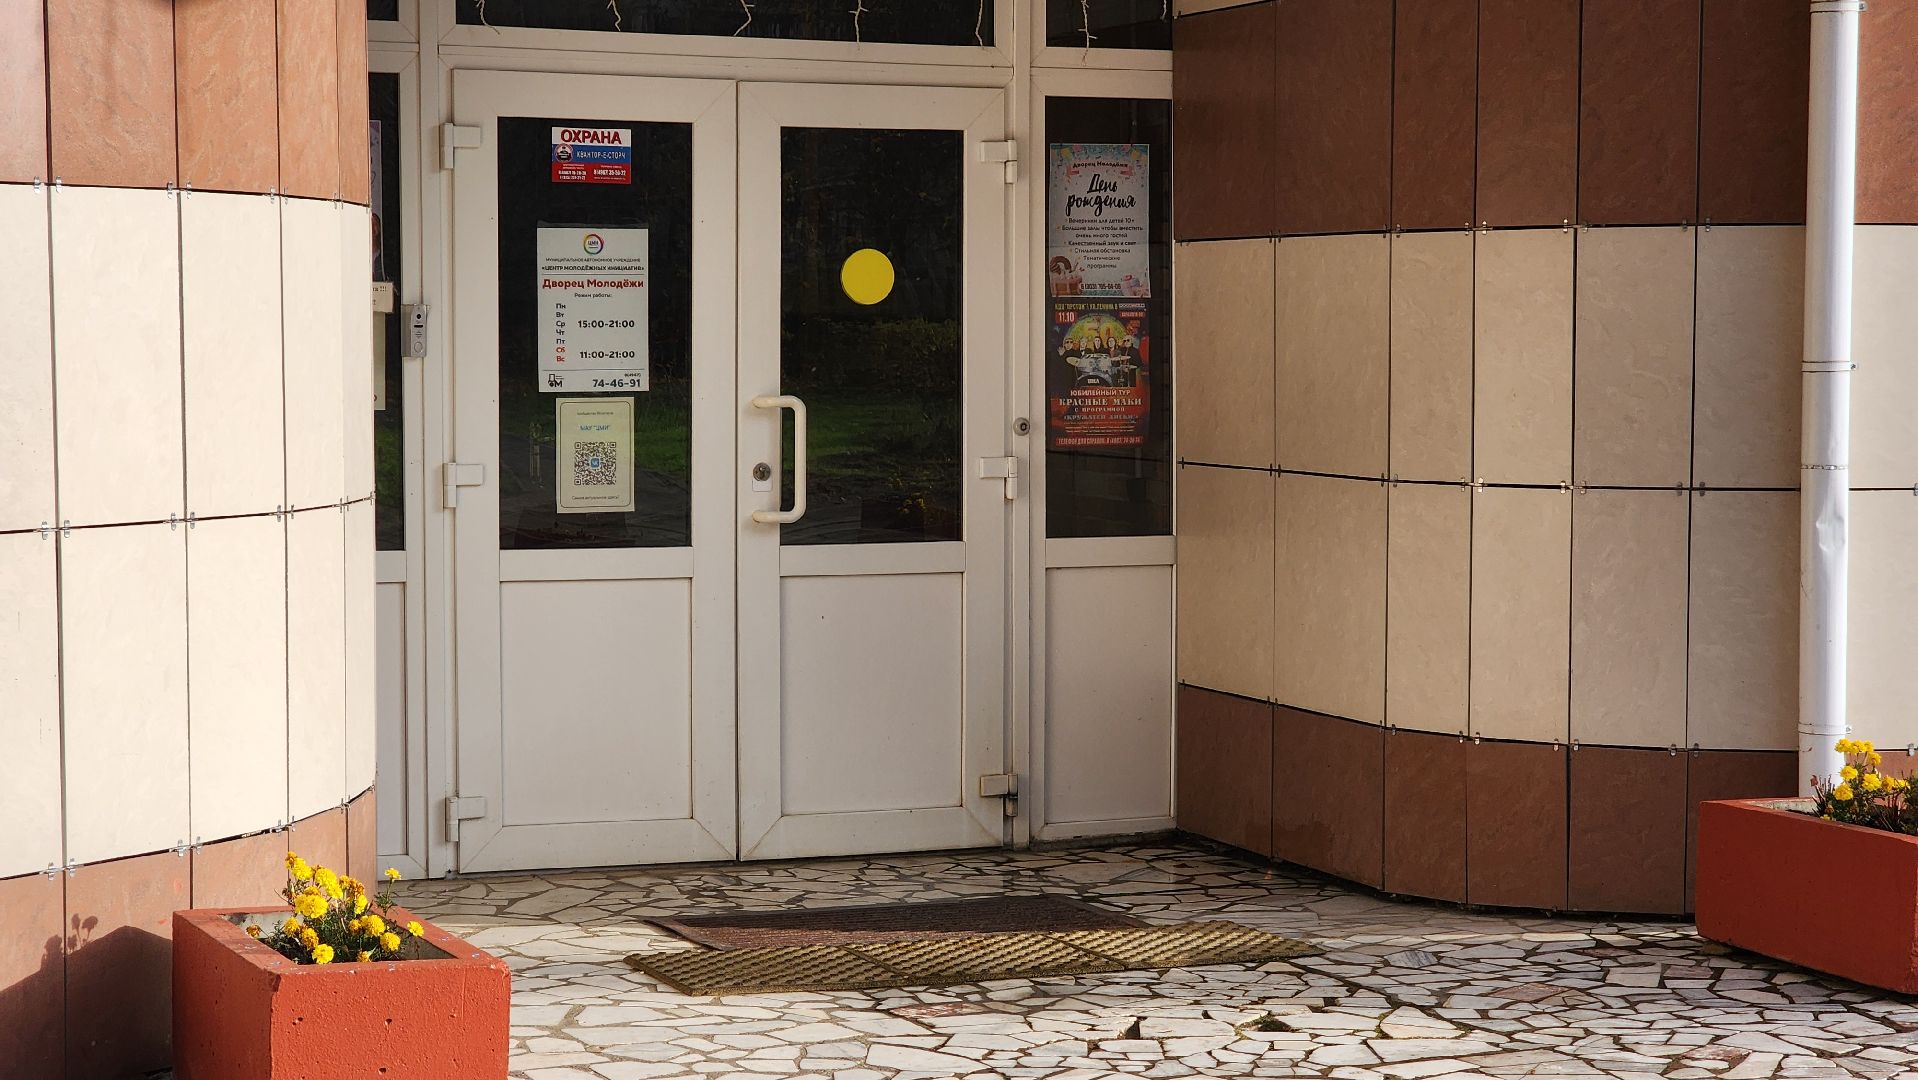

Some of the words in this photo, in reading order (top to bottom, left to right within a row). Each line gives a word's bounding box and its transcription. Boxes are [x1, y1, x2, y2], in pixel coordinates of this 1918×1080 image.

[560, 129, 622, 144] ОХРАНА
[1087, 174, 1117, 194] День
[1066, 194, 1136, 216] рождения
[542, 279, 584, 290] Дворец
[587, 279, 644, 289] Молодёжи
[1058, 312, 1075, 322] 11.10
[592, 379, 641, 387] 74-46-91
